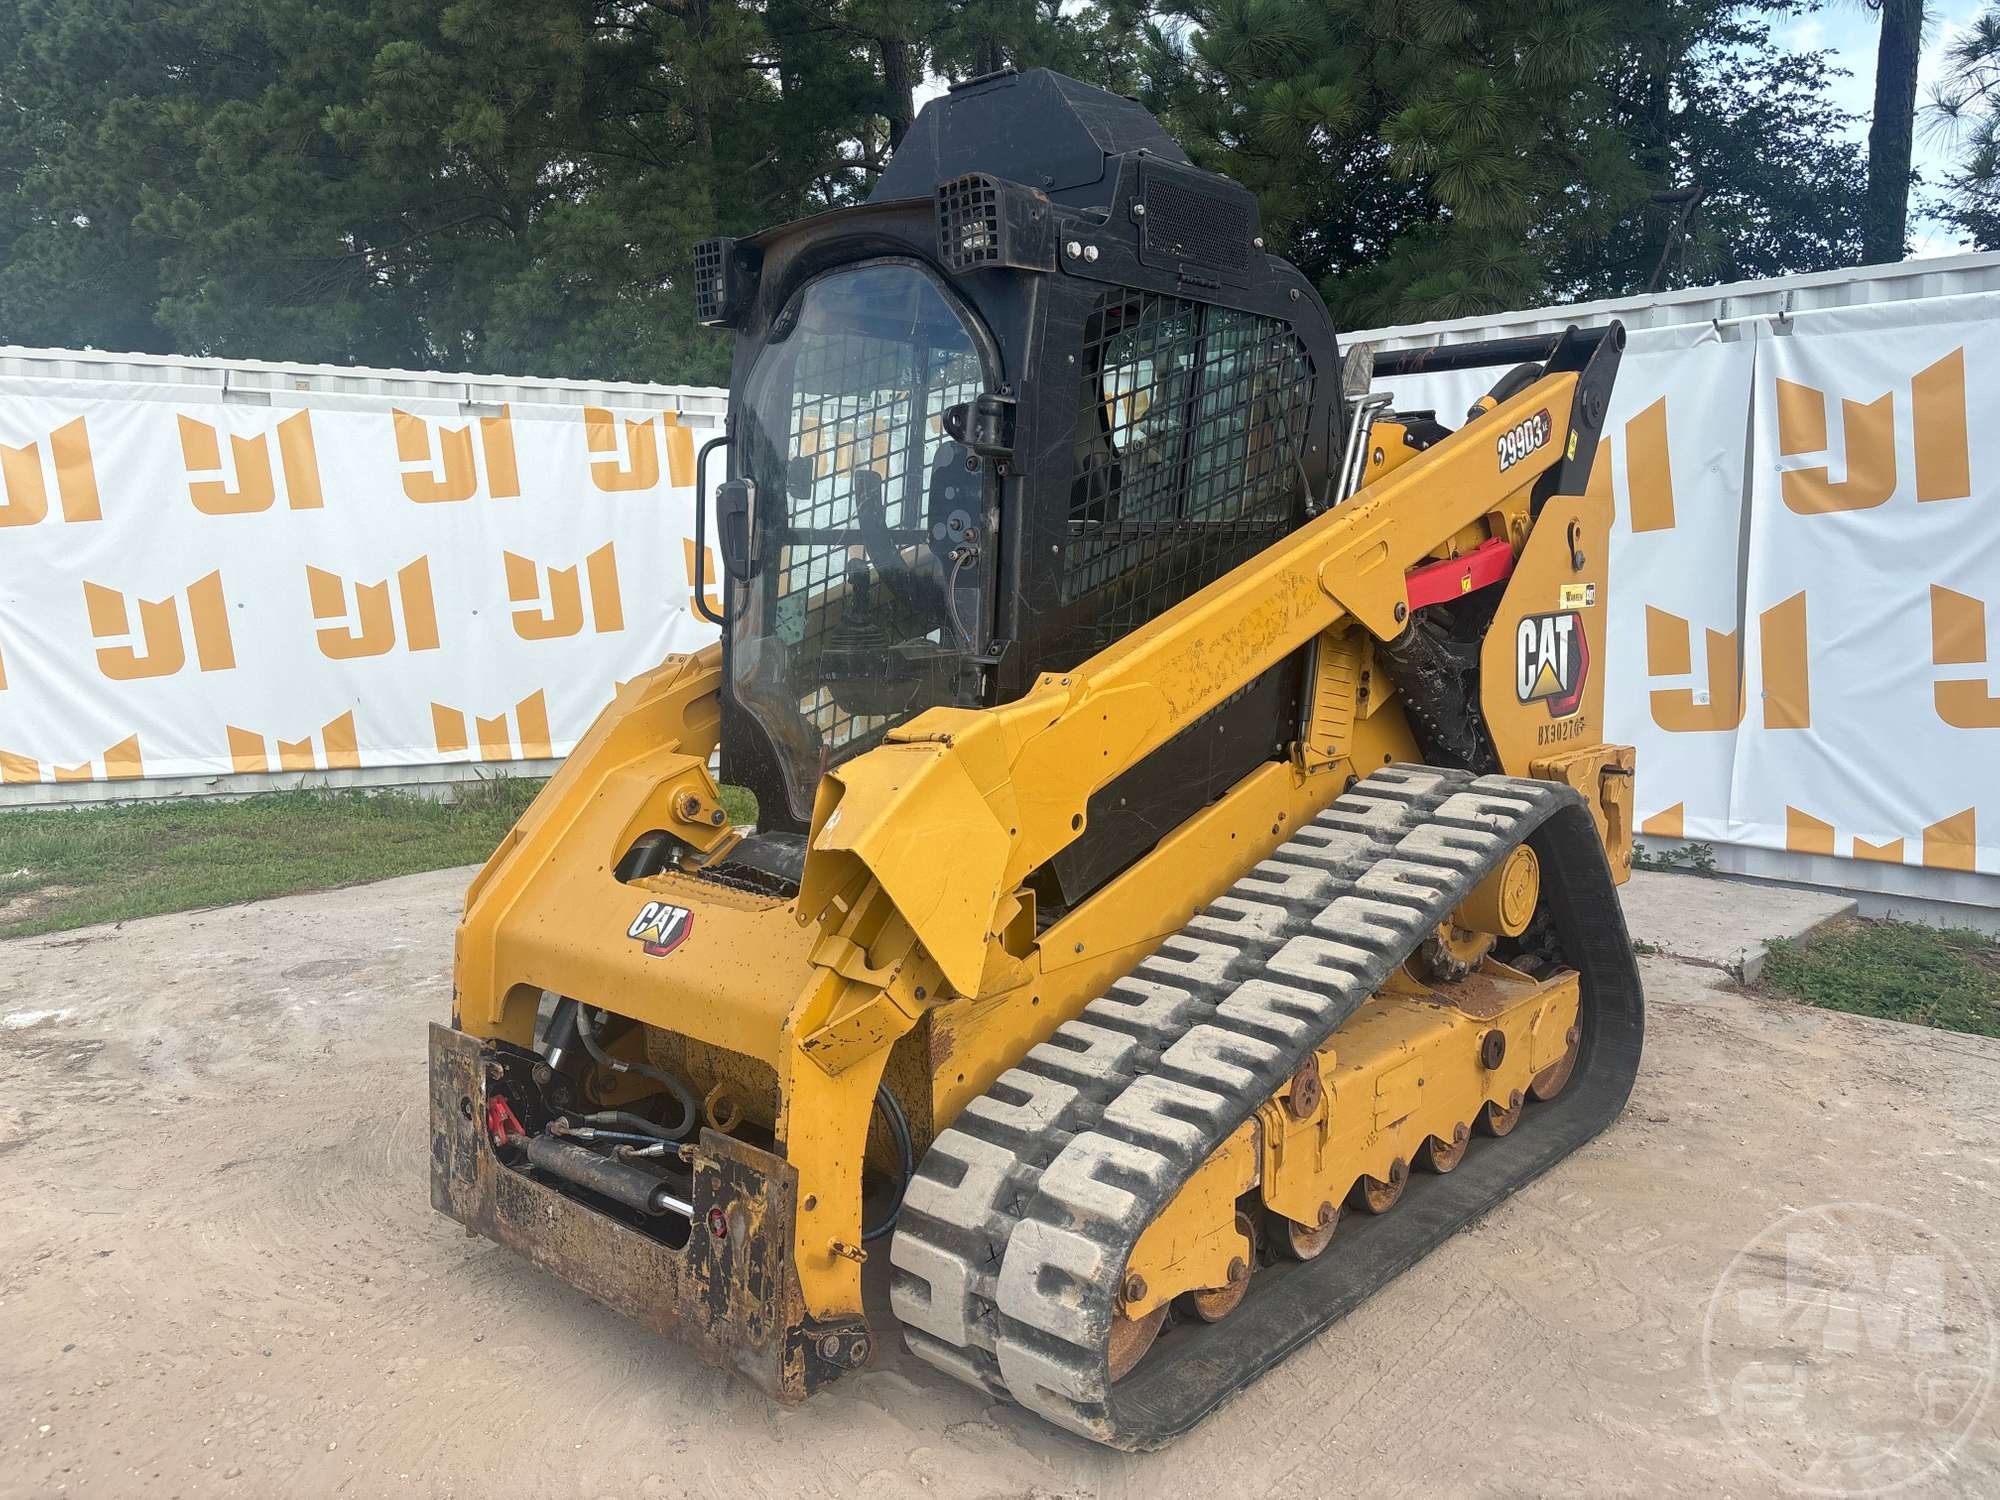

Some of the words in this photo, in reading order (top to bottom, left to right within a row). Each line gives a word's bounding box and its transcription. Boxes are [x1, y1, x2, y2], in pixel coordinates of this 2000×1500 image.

[1498, 415, 1542, 471] 299D3
[1517, 614, 1574, 700] CAT
[628, 902, 689, 944] CAT
